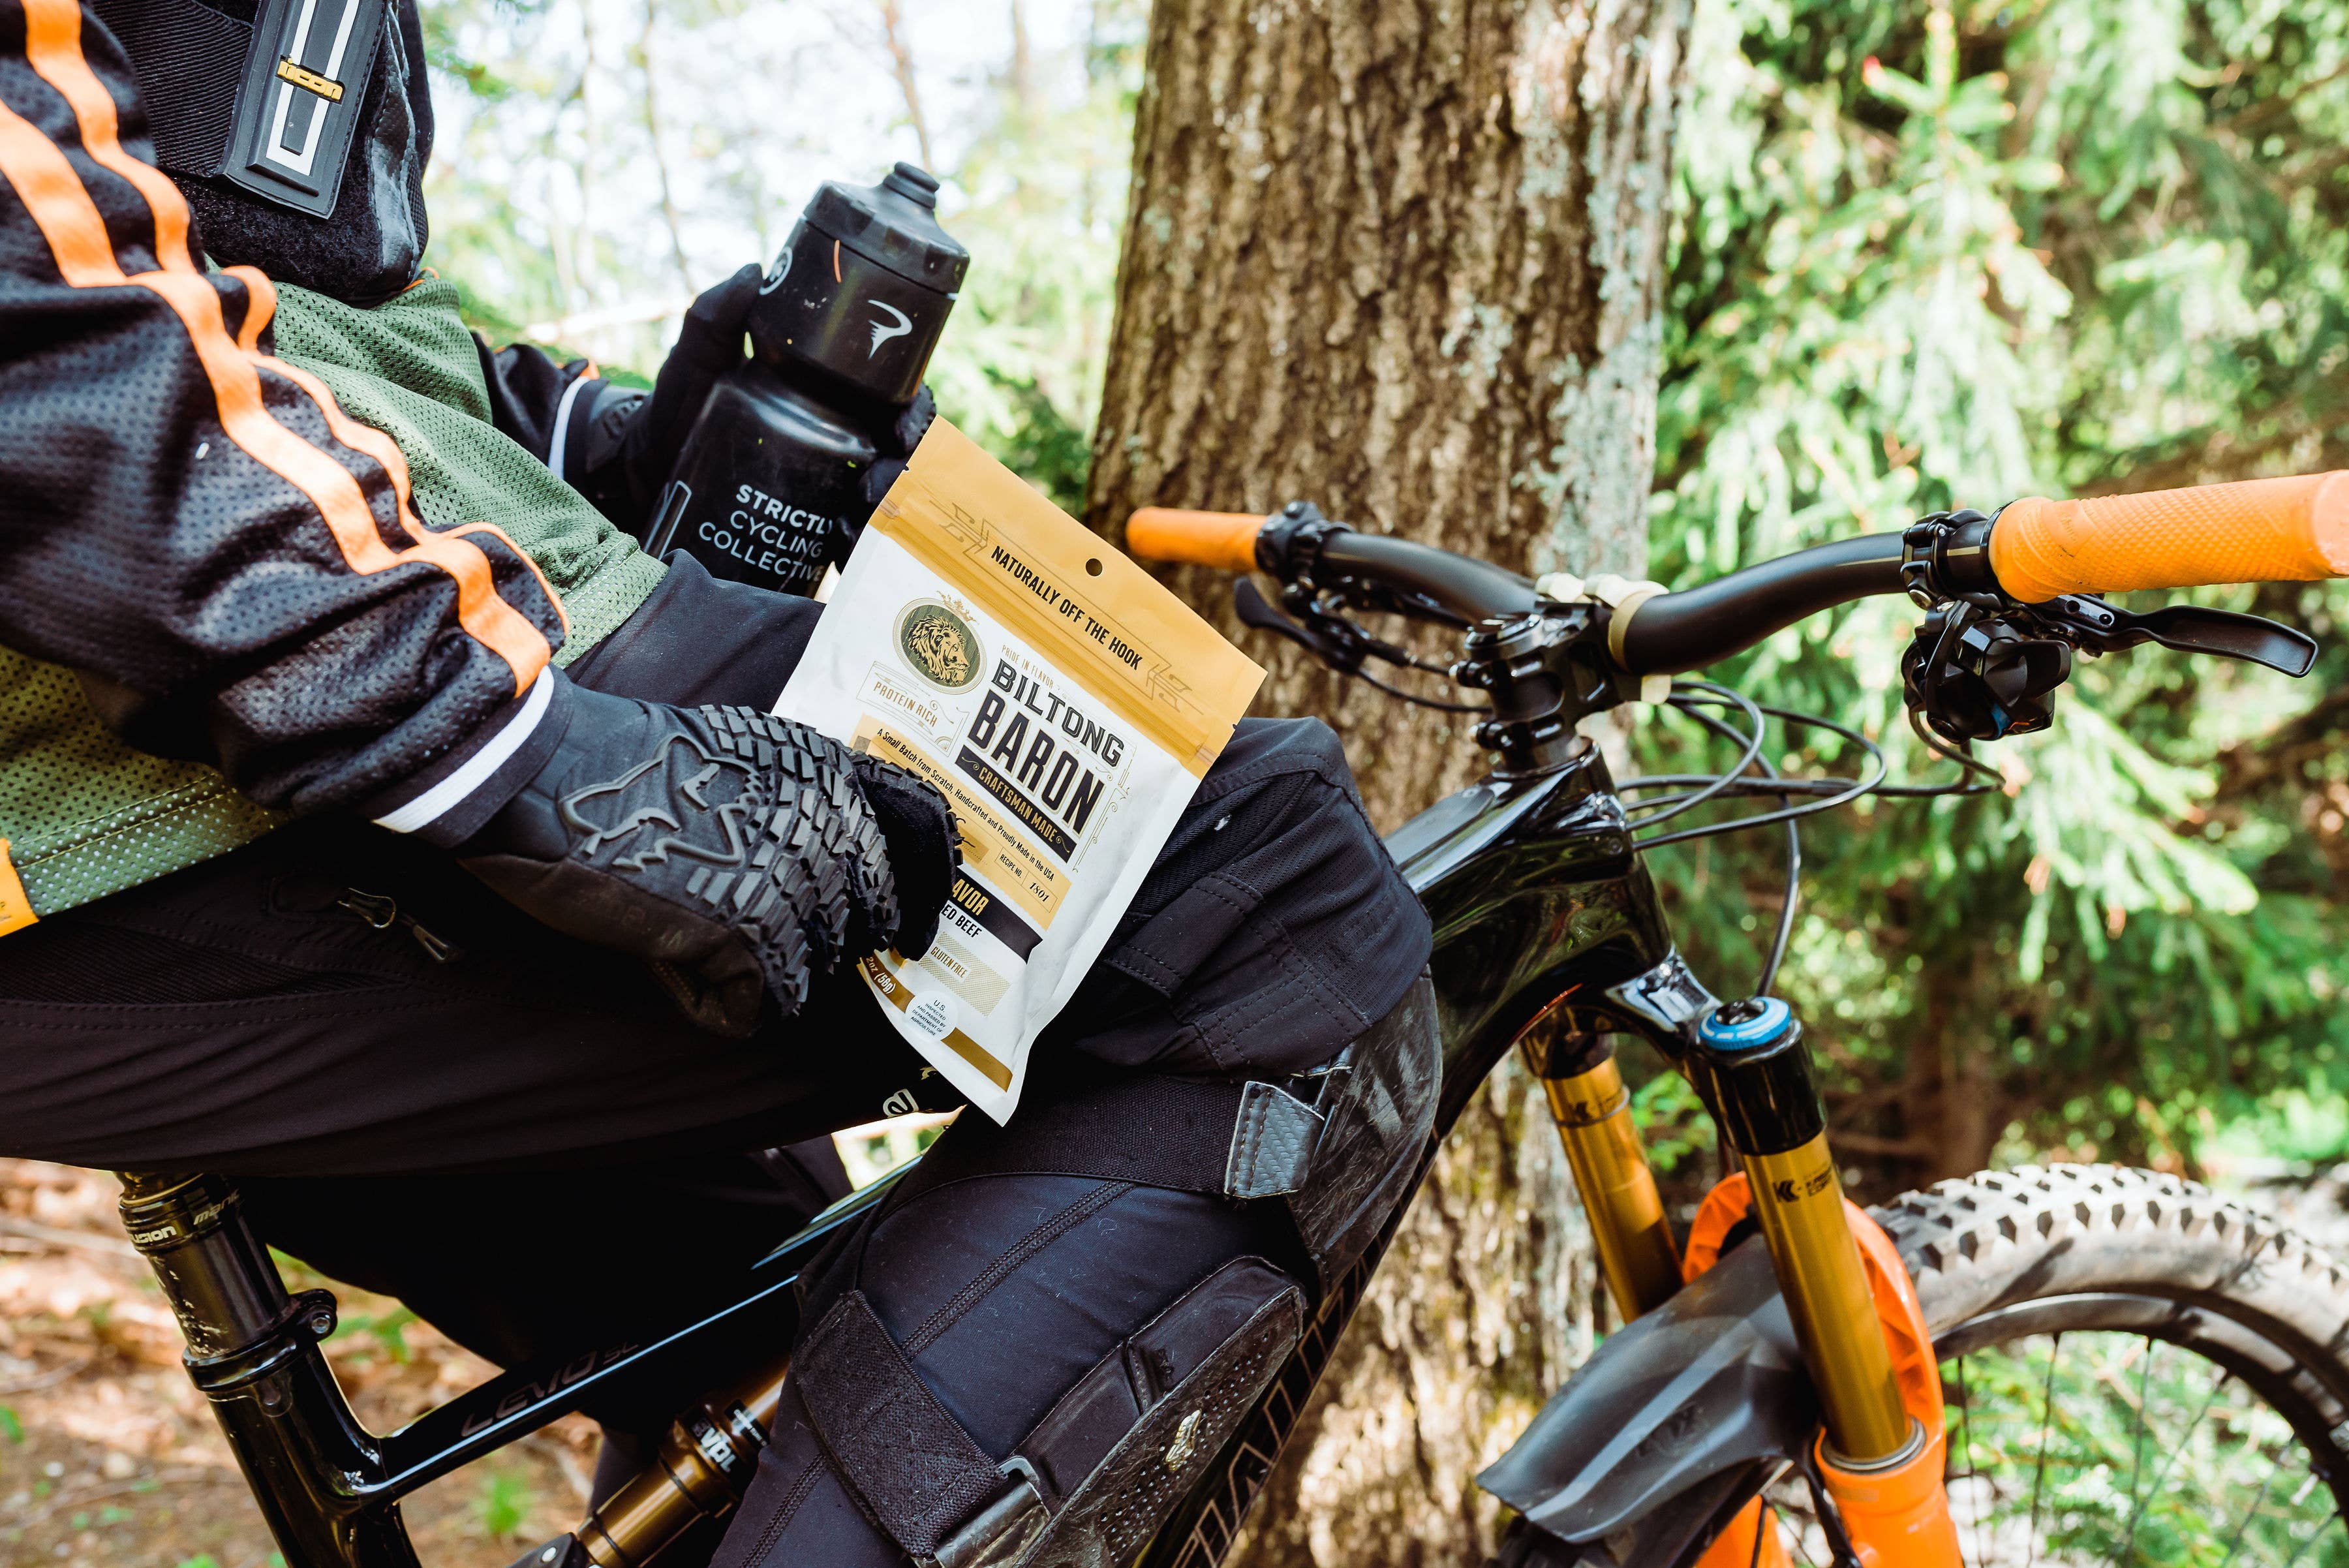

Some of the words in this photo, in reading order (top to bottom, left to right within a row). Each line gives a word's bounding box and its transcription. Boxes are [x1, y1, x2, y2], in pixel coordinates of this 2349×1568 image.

[699, 522, 823, 581] COLLECTIVE
[730, 510, 821, 557] CYCLING
[991, 546, 1061, 605] NATURALLY
[1059, 598, 1084, 624] OFF
[1084, 616, 1109, 646] THE
[1109, 636, 1143, 671] HOOK
[1001, 645, 1021, 663] PRIDE
[1021, 659, 1031, 671] IN
[1031, 666, 1055, 689] FLAVOR
[873, 682, 916, 711] PROTEIN
[916, 704, 938, 728] RICH
[990, 659, 1124, 767] BILTONG
[967, 689, 1105, 835] BARON
[877, 728, 884, 737] A
[883, 731, 901, 749] Small
[899, 745, 918, 763] Batch
[917, 758, 931, 774] from
[930, 769, 955, 794] Scratch,
[954, 789, 989, 821] Handcrafted
[987, 816, 998, 829] and
[996, 826, 1017, 848] Proudly
[1015, 843, 1030, 859] Made
[1029, 854, 1037, 864] in
[1034, 859, 1045, 872] the
[1043, 868, 1055, 882] USA
[979, 767, 1032, 823] CRAFTSMAN
[1032, 812, 1057, 842] MADE
[952, 878, 989, 916] AVOR
[998, 854, 1016, 872] RECIPE
[1013, 867, 1024, 878] NO.
[1028, 881, 1050, 903] 1801
[941, 904, 957, 921] ED
[955, 915, 982, 938] BEEF
[866, 956, 878, 972] 2oz
[930, 946, 953, 967] GLUTEN
[951, 962, 967, 978] FREE
[910, 1017, 936, 1036] AGRICULTURE
[912, 1009, 937, 1029] DEPARTMENT
[917, 1005, 926, 1013] AND
[925, 1011, 940, 1024] PASSED
[925, 1004, 946, 1021] INSPECTED
[933, 1000, 946, 1013] U.S.
